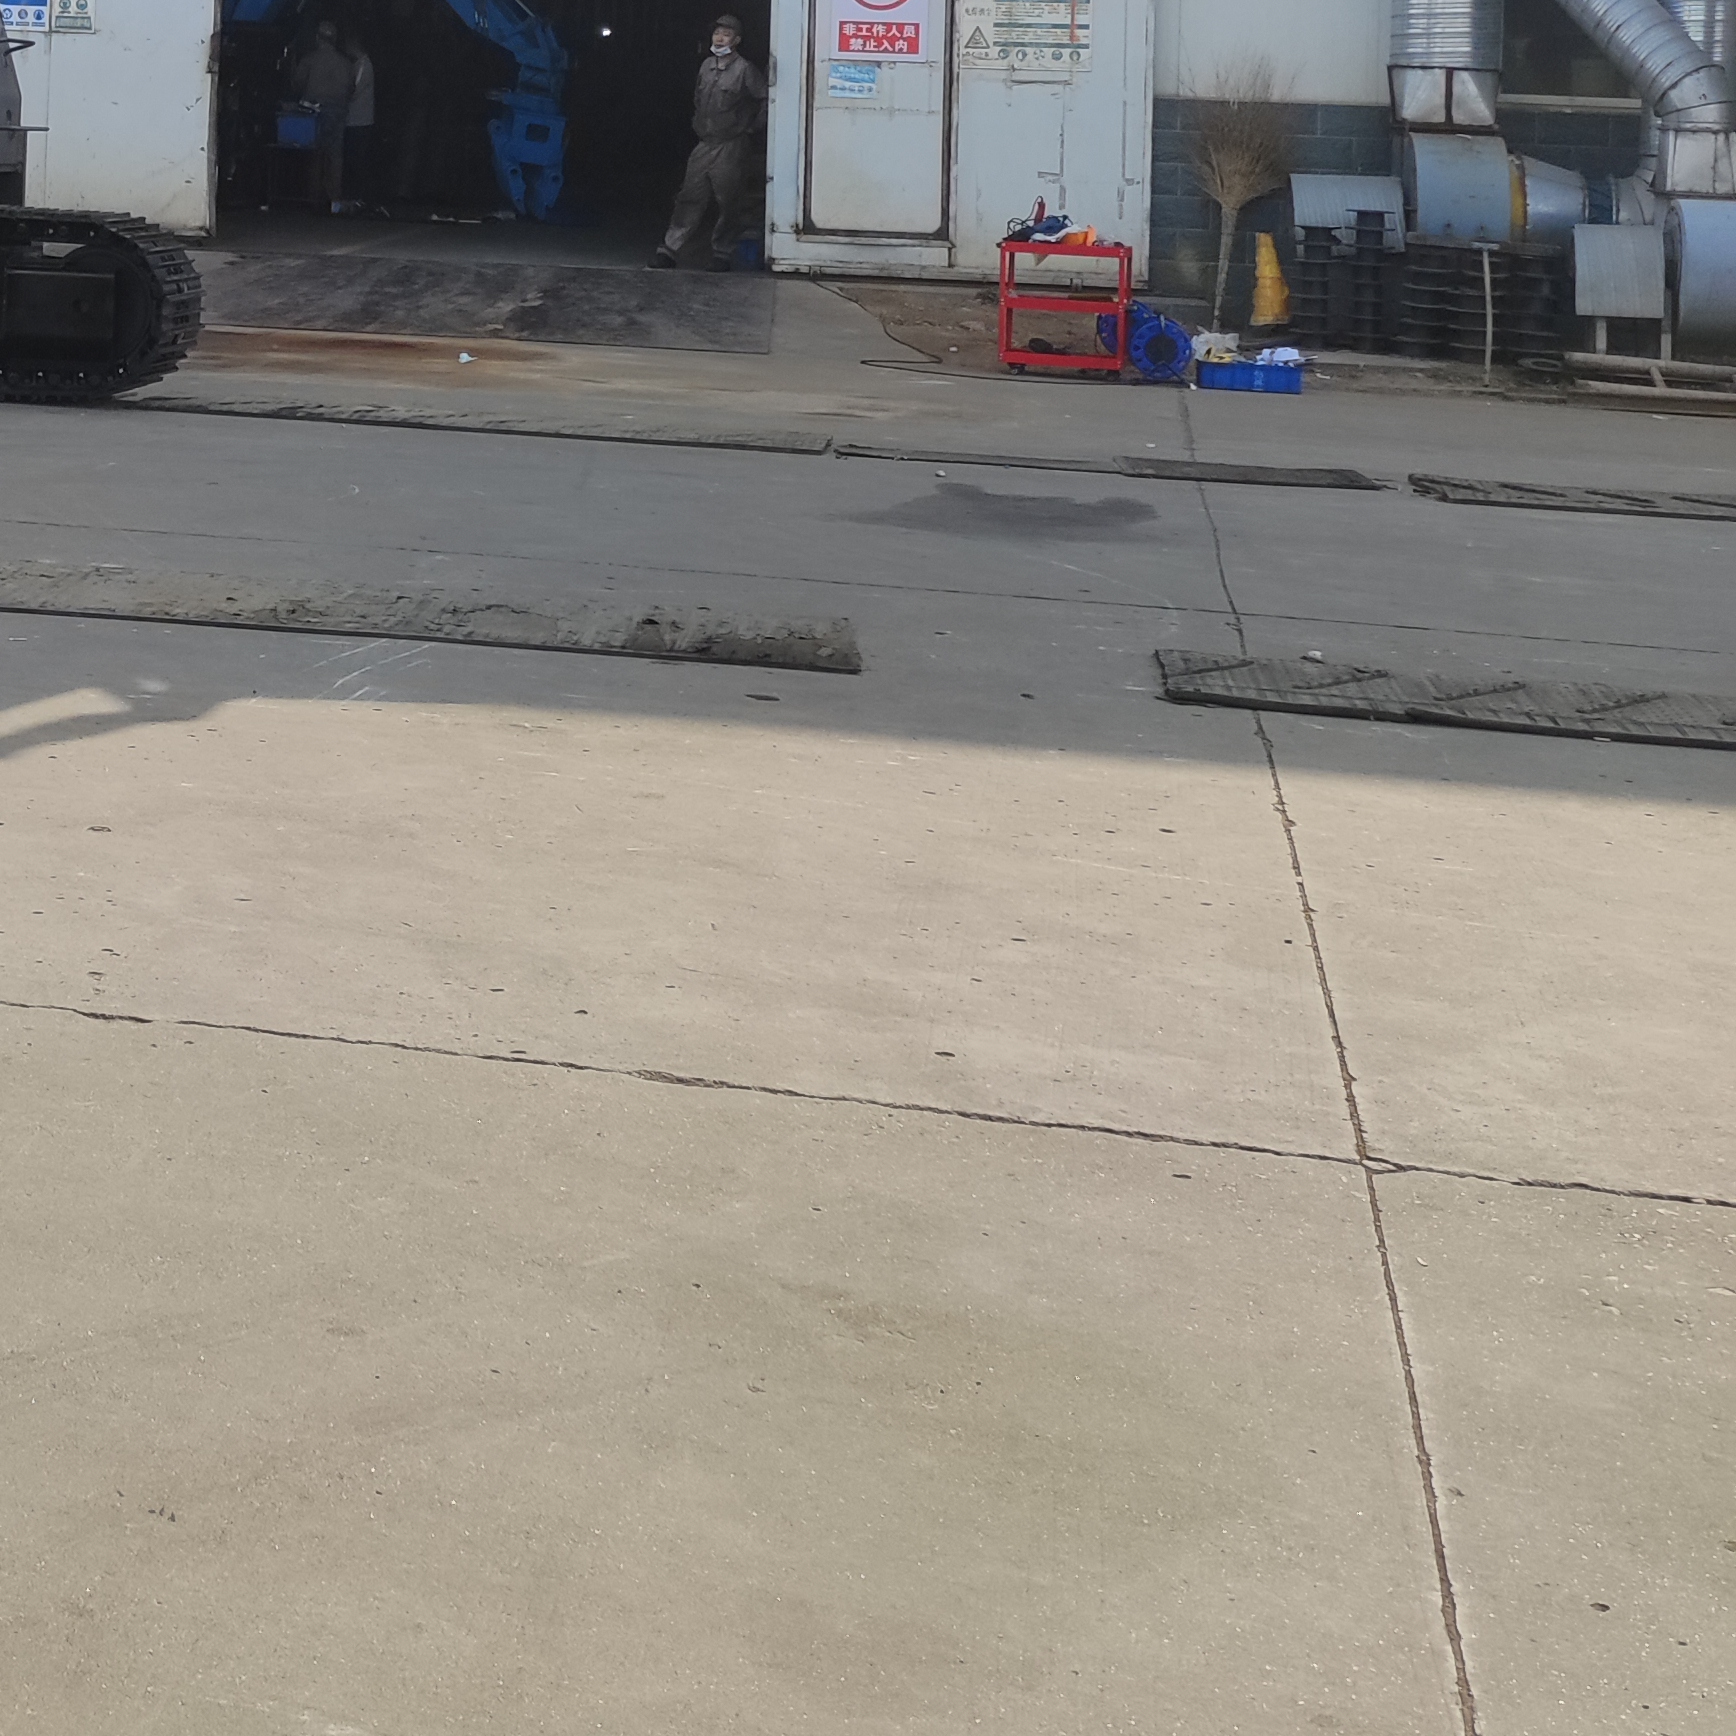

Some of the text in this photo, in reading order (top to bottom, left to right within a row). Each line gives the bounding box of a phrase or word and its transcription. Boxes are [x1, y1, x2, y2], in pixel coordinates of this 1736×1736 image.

[842, 22, 916, 38] 非工作人员
[849, 38, 909, 53] 禁止入内
